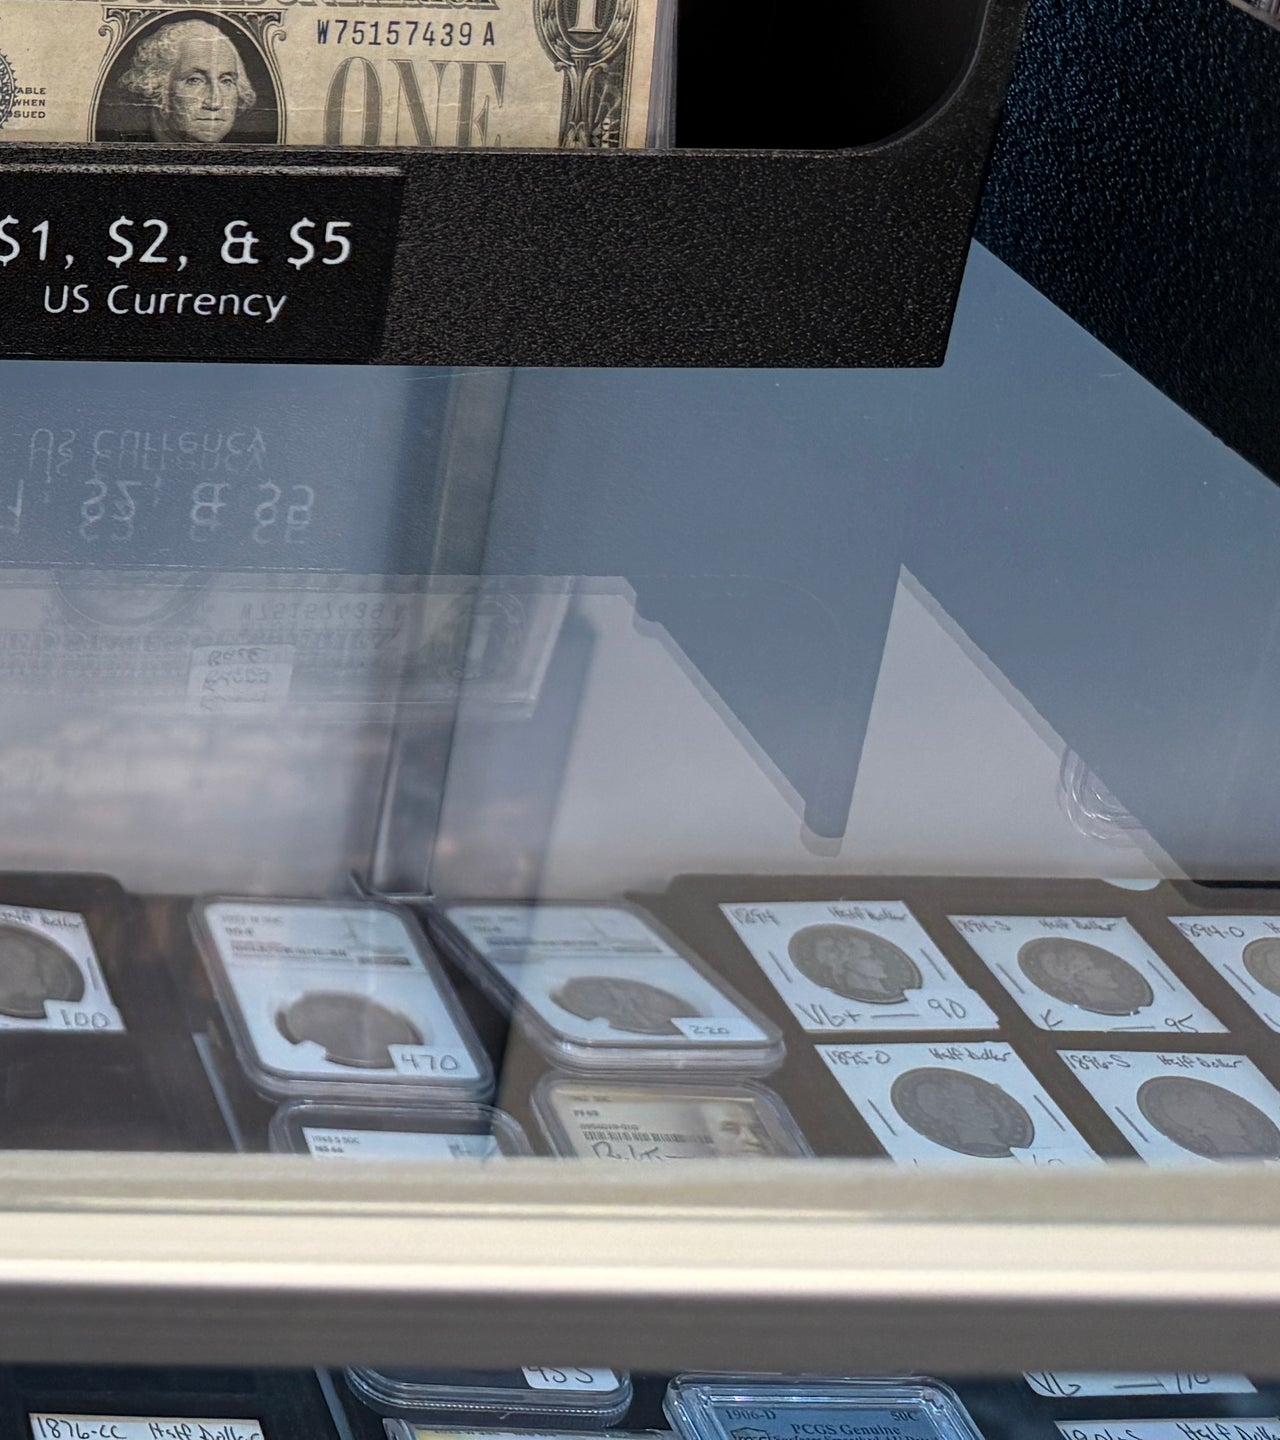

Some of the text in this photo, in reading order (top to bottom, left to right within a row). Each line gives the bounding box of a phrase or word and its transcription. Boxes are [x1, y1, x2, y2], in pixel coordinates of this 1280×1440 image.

[317, 19, 495, 47] W75157439 A
[107, 215, 188, 271] $2,
[221, 220, 259, 265] &
[288, 217, 352, 270] $5
[43, 284, 288, 323] US Currency
[62, 1009, 110, 1029] 100
[927, 997, 967, 1021] 90
[401, 1054, 458, 1071] 470
[791, 1423, 900, 1435] PCGS Genuine
